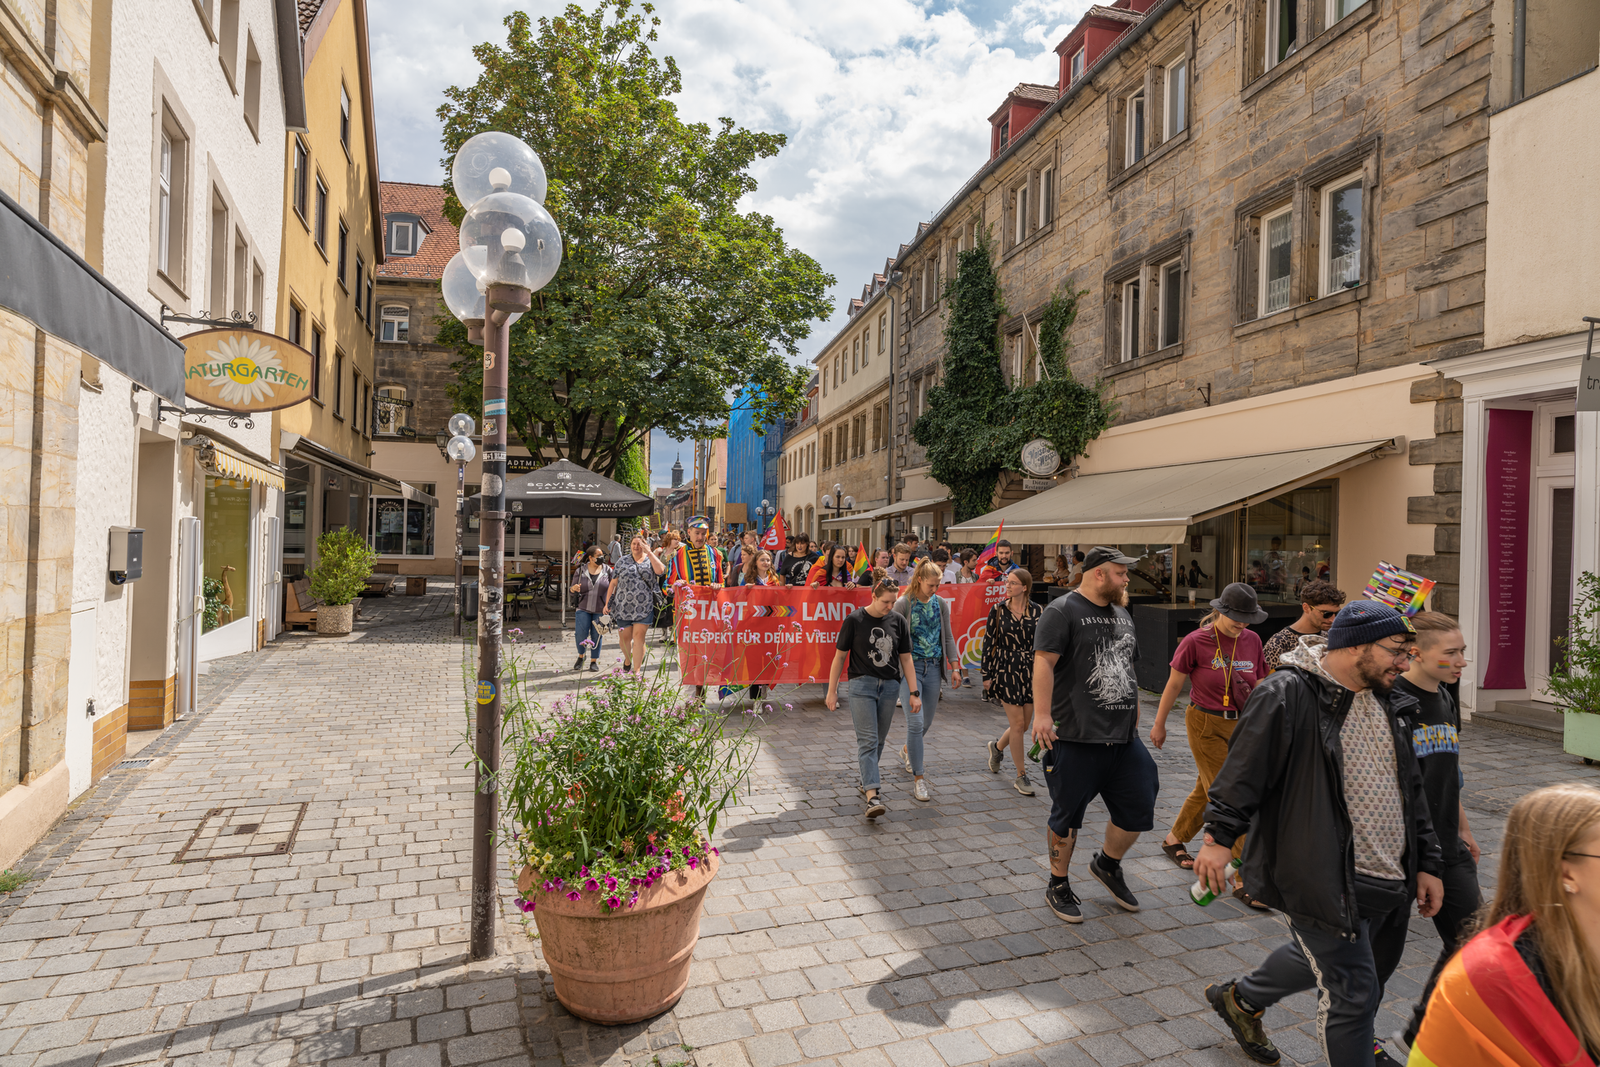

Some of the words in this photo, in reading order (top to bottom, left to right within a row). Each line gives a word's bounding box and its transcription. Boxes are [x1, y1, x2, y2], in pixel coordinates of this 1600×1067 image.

[185, 362, 309, 391] ATURGARTEN
[1586, 375, 1600, 390] tr
[984, 585, 1007, 596] SPD
[984, 596, 1006, 605] queer
[683, 599, 748, 621] STADT
[802, 601, 856, 621] LAND
[682, 631, 734, 644] RESPEKT
[737, 629, 762, 644] FÜR
[764, 632, 803, 644] DEINE
